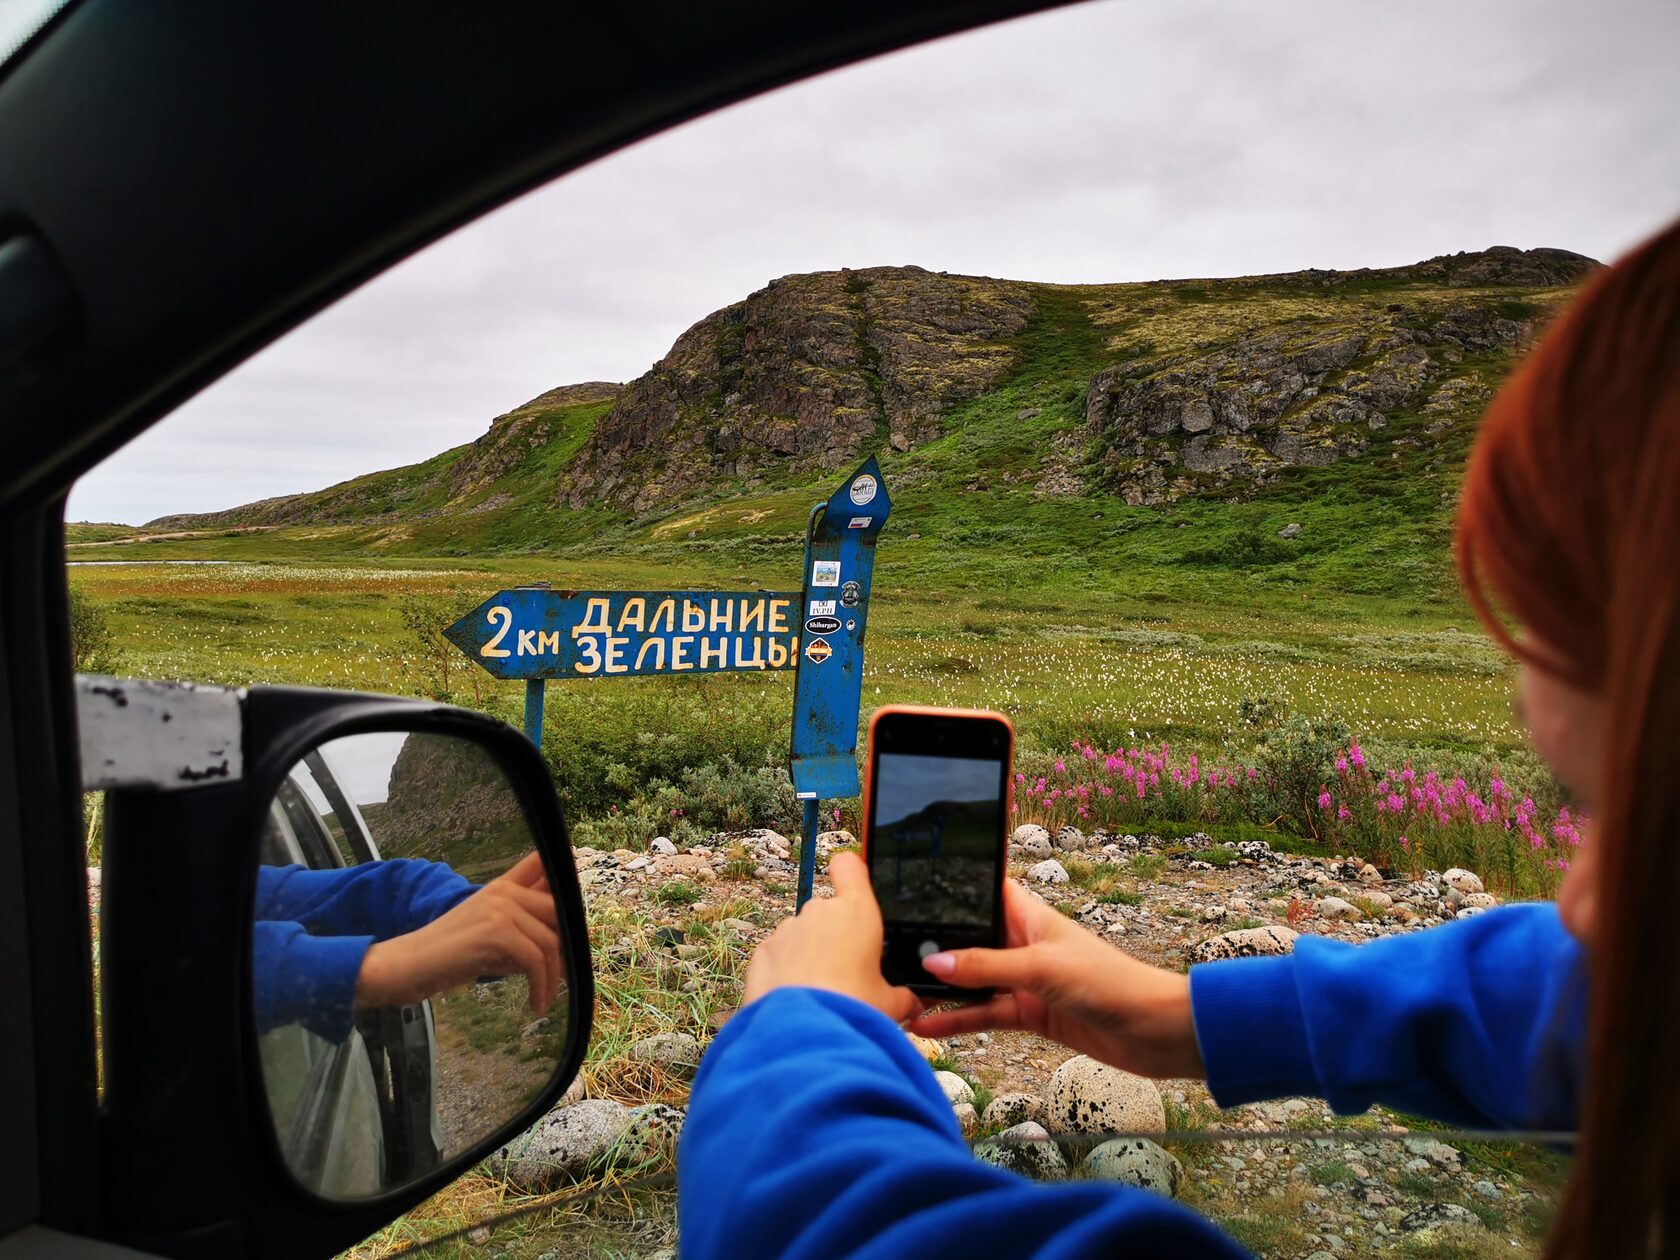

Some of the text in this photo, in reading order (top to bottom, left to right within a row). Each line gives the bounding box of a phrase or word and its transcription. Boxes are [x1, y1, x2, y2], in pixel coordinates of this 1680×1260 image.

[480, 606, 513, 657] 2
[571, 598, 790, 638] ДАЛЬНИЕ
[574, 635, 798, 674] ЗЕЛЕНЦЫ
